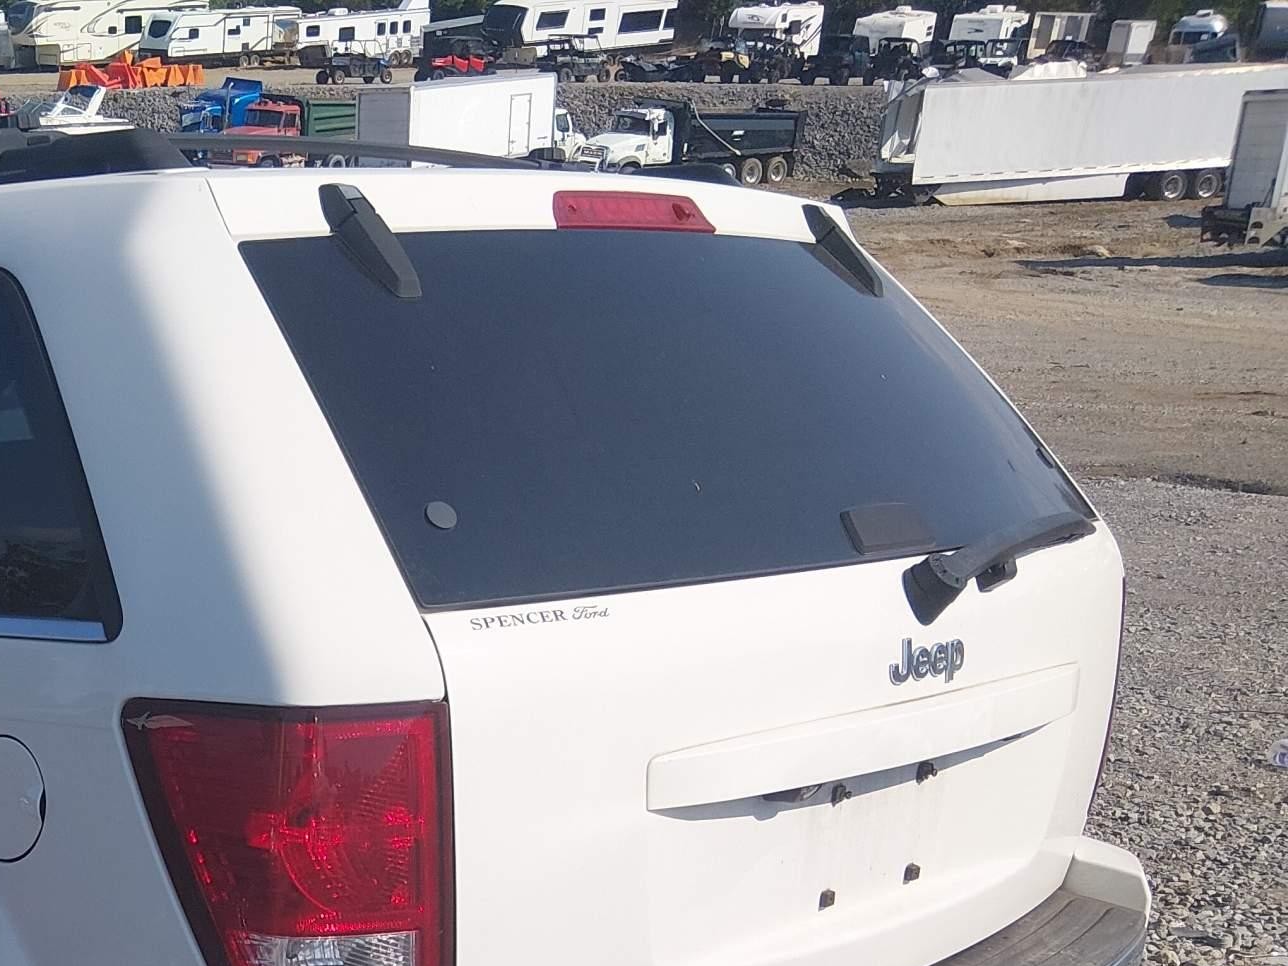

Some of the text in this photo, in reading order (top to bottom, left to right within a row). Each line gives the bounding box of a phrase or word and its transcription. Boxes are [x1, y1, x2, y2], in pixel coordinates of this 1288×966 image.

[470, 605, 610, 631] SPENCER Ford
[889, 637, 964, 686] Jeep
